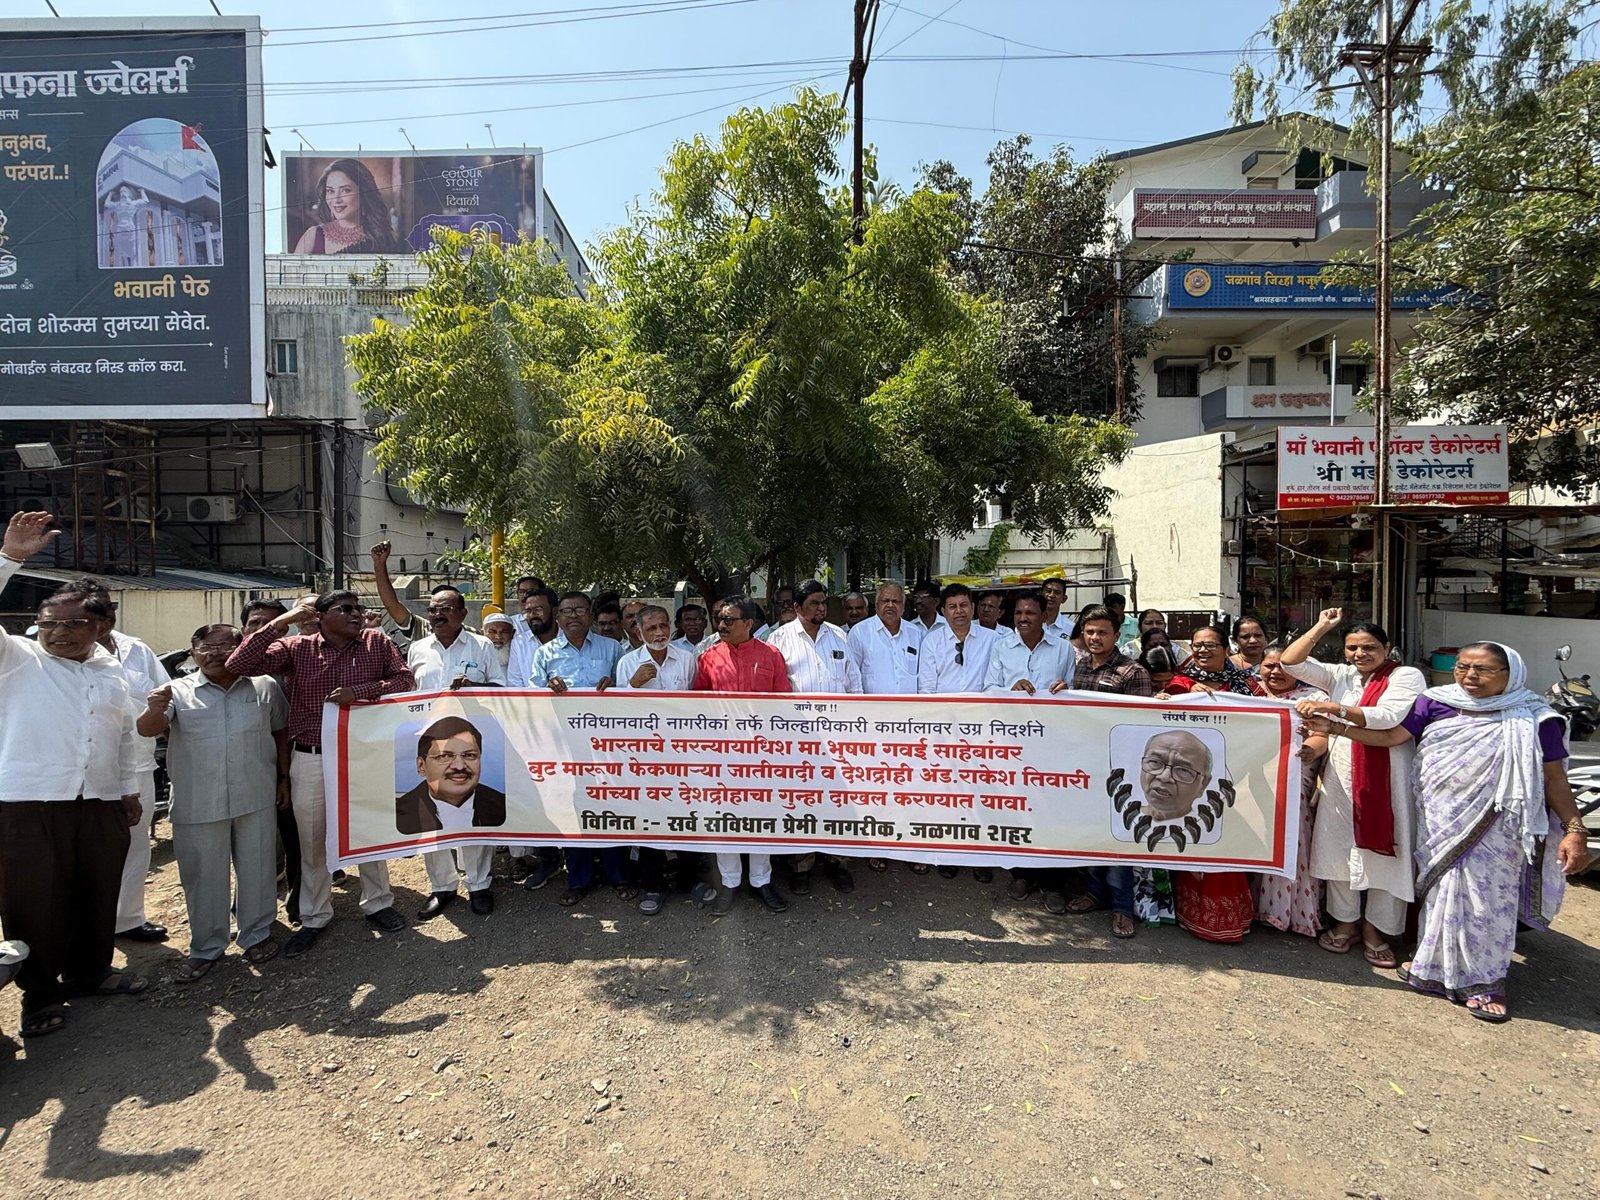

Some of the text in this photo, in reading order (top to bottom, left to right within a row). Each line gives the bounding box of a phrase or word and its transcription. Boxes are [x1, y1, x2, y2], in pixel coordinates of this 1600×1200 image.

[84, 56, 194, 95] ज्वेलर्स
[0, 134, 51, 157] नुभव,
[441, 170, 483, 179] COLOUR
[446, 179, 479, 187] STONE
[114, 274, 210, 298] भवानी पेठ
[1225, 272, 1261, 286] जळगांव
[0, 311, 210, 338] दोन शोरूम्स तुमच्या सेवेत.
[0, 358, 186, 375] मोबाईल नंबरवर मिस्ड कॉल करा.
[1312, 436, 1364, 455] भवानी
[1429, 433, 1501, 455] डेकोरेटर्स
[1316, 461, 1343, 481] श्री
[1396, 458, 1474, 479] डेकोरेटर्स
[794, 702, 812, 712] जागे
[567, 712, 1045, 737] संविधानवादी नागरीकां तर्फे जिल्हाधिकारी कार्यालावर उग्र निदर्शने
[1189, 714, 1209, 723] करा
[1213, 715, 1227, 724] !!!
[590, 733, 665, 753] भारताचे
[671, 735, 793, 755] सरन्यायाधिश
[882, 738, 928, 760] गवई
[933, 738, 1024, 762] साहेबांवर
[528, 761, 557, 782] बुट
[727, 759, 816, 782] जातीवादी
[821, 765, 836, 781] व
[841, 761, 914, 785] देशद्रोही
[1021, 766, 1092, 790] तिवारी
[585, 781, 1033, 812] यांच्या वर देशद्रोहाचा गुन्हा दाखल करण्यात यावा.
[582, 810, 637, 831] विनित
[667, 811, 698, 832] सर्व
[704, 811, 777, 834] संविधान
[782, 813, 818, 834] प्रेमी
[823, 815, 903, 841] नागरीक,
[910, 817, 982, 841] जळगांव
[987, 824, 1032, 845] शहर
